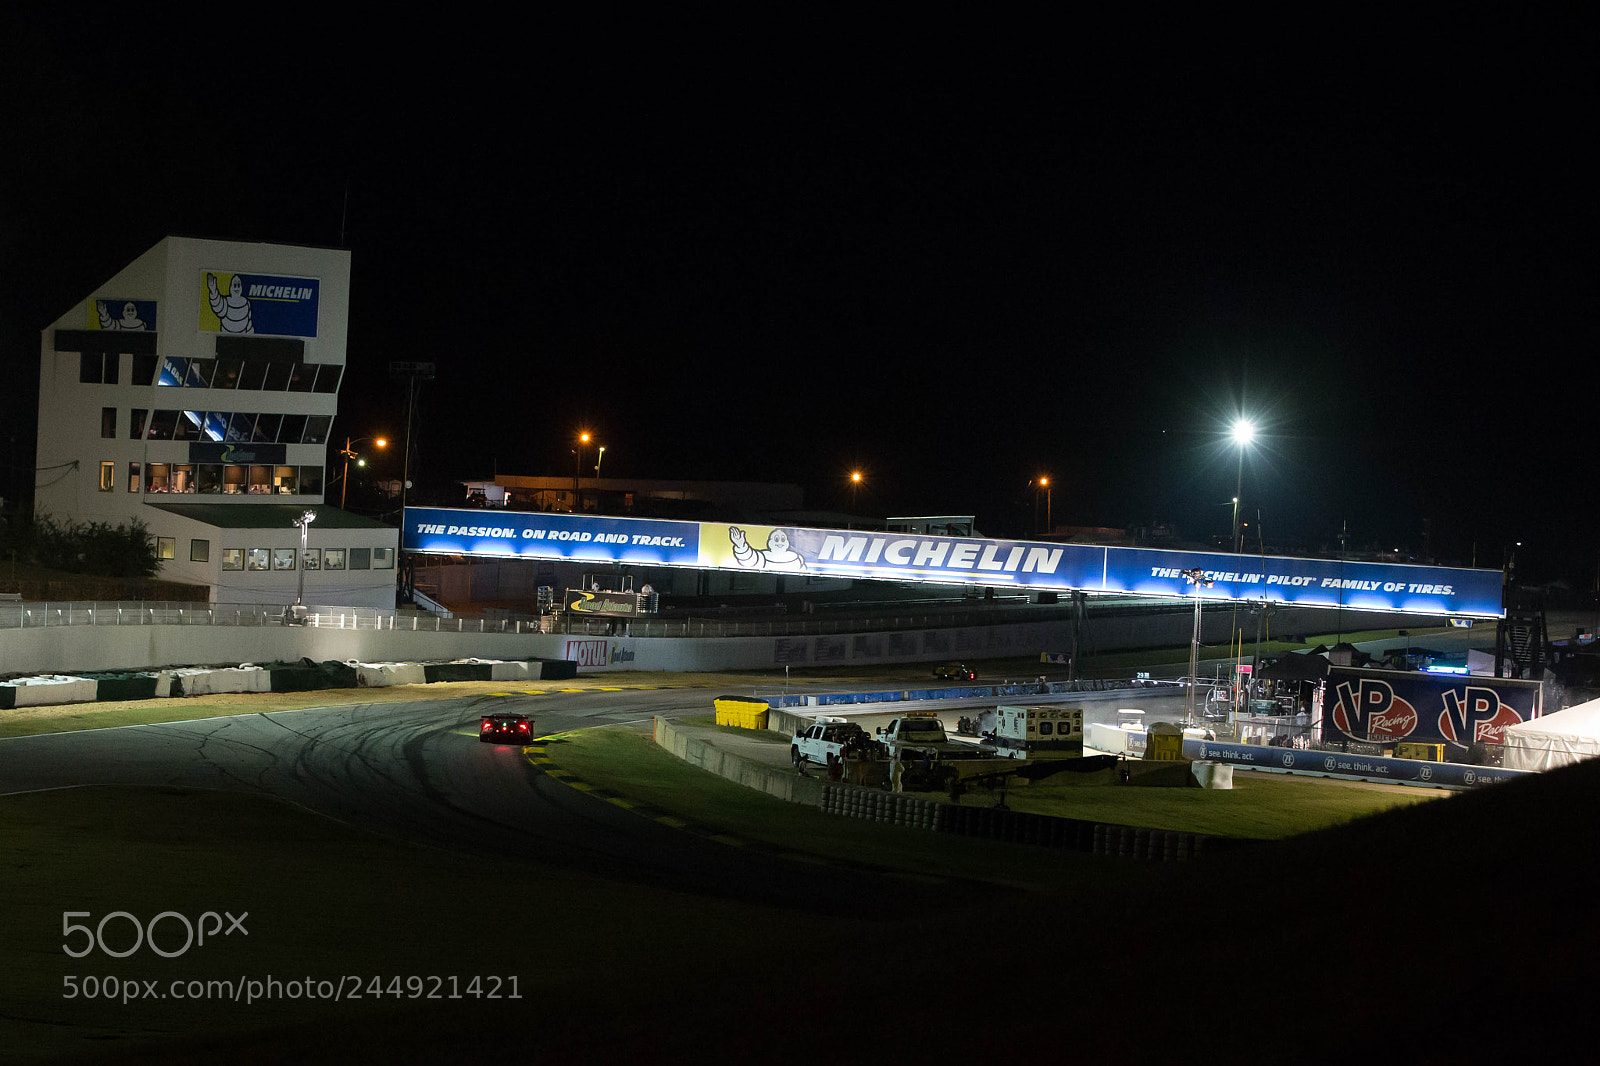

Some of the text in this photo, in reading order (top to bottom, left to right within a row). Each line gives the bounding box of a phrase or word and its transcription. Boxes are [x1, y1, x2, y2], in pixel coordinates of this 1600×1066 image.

[248, 284, 313, 300] MICHELIN
[417, 523, 686, 548] THE PASSION. ON ROAD AND TRACK.
[818, 535, 1065, 574] MICHELIN
[1151, 567, 1181, 579] THE
[1321, 577, 1380, 592] FAMILY
[1383, 581, 1406, 593] OF
[1408, 583, 1456, 596] TIRES.
[568, 641, 607, 666] MOTUL
[1336, 679, 1394, 742] VP
[1441, 686, 1500, 746] VP
[1372, 713, 1417, 734] Racing
[1222, 749, 1241, 760] think.
[1337, 762, 1352, 770] see.
[1353, 761, 1374, 772] think.
[1375, 765, 1389, 774] act.
